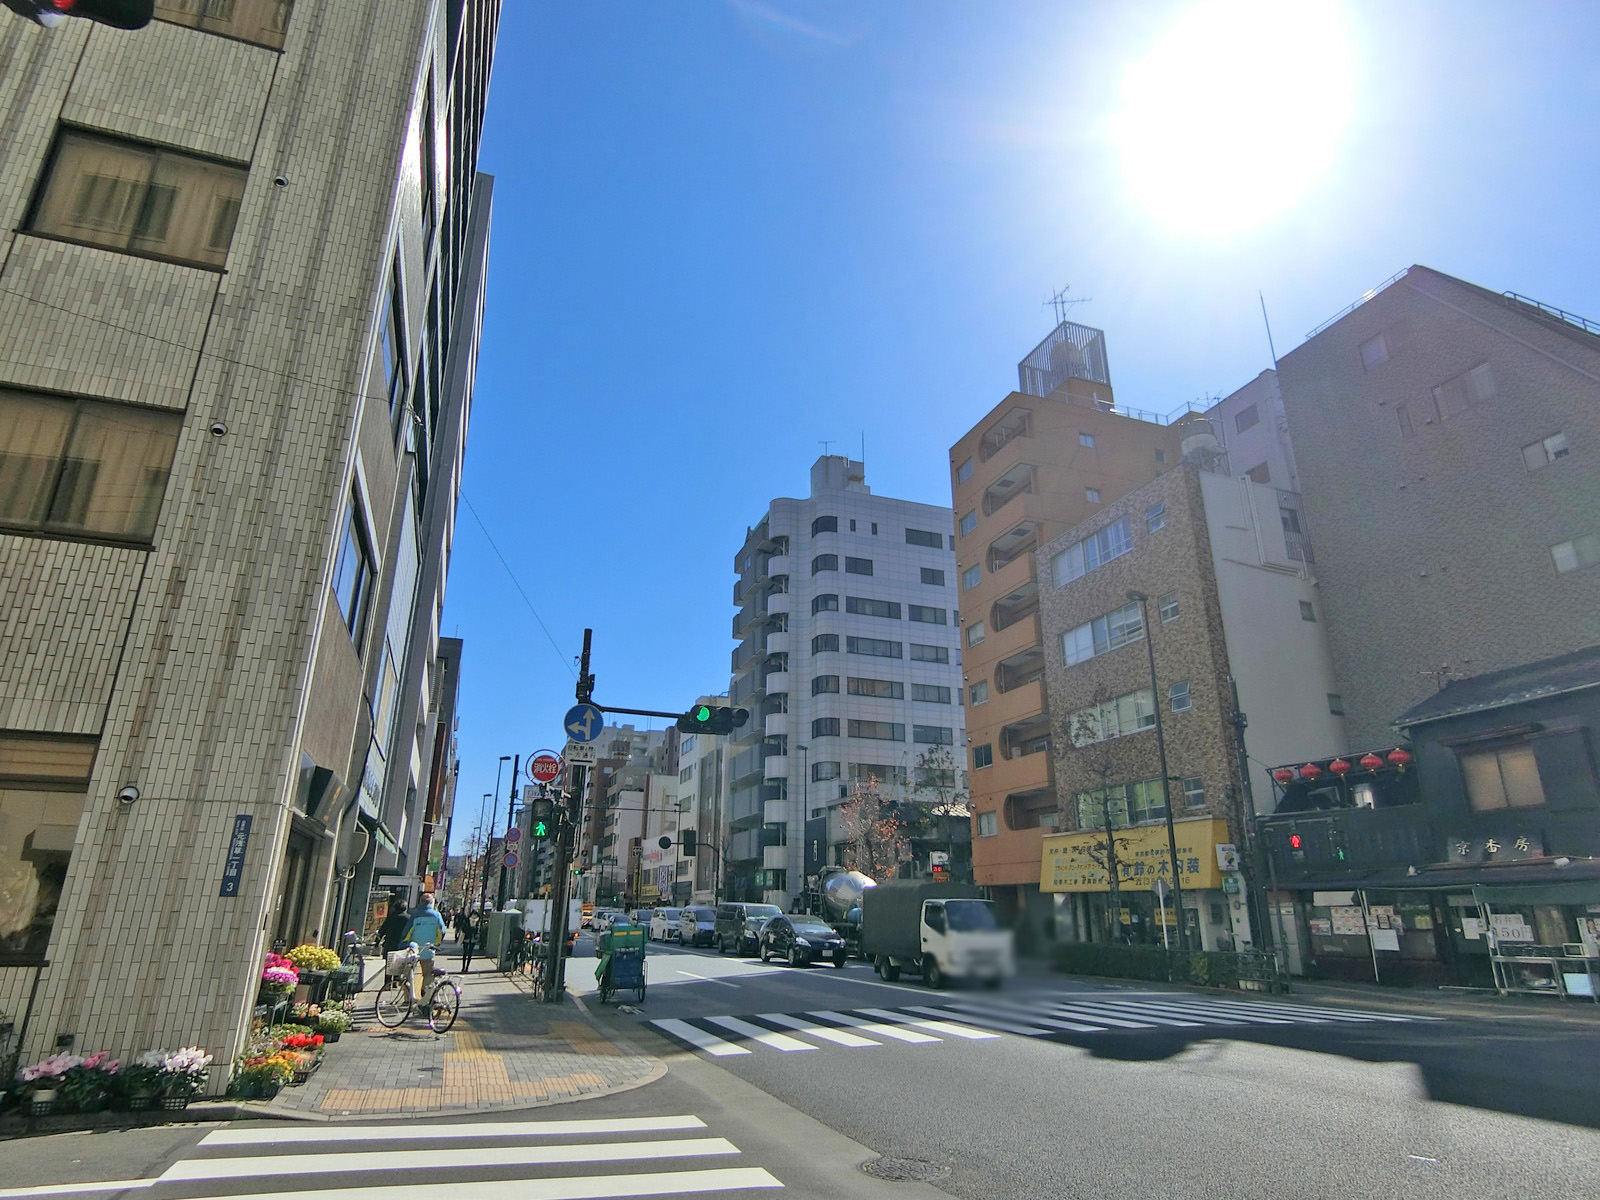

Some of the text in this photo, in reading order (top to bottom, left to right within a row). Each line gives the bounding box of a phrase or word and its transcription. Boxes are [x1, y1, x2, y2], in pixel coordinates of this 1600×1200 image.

[533, 762, 557, 774] 消火栓
[226, 882, 234, 892] 3
